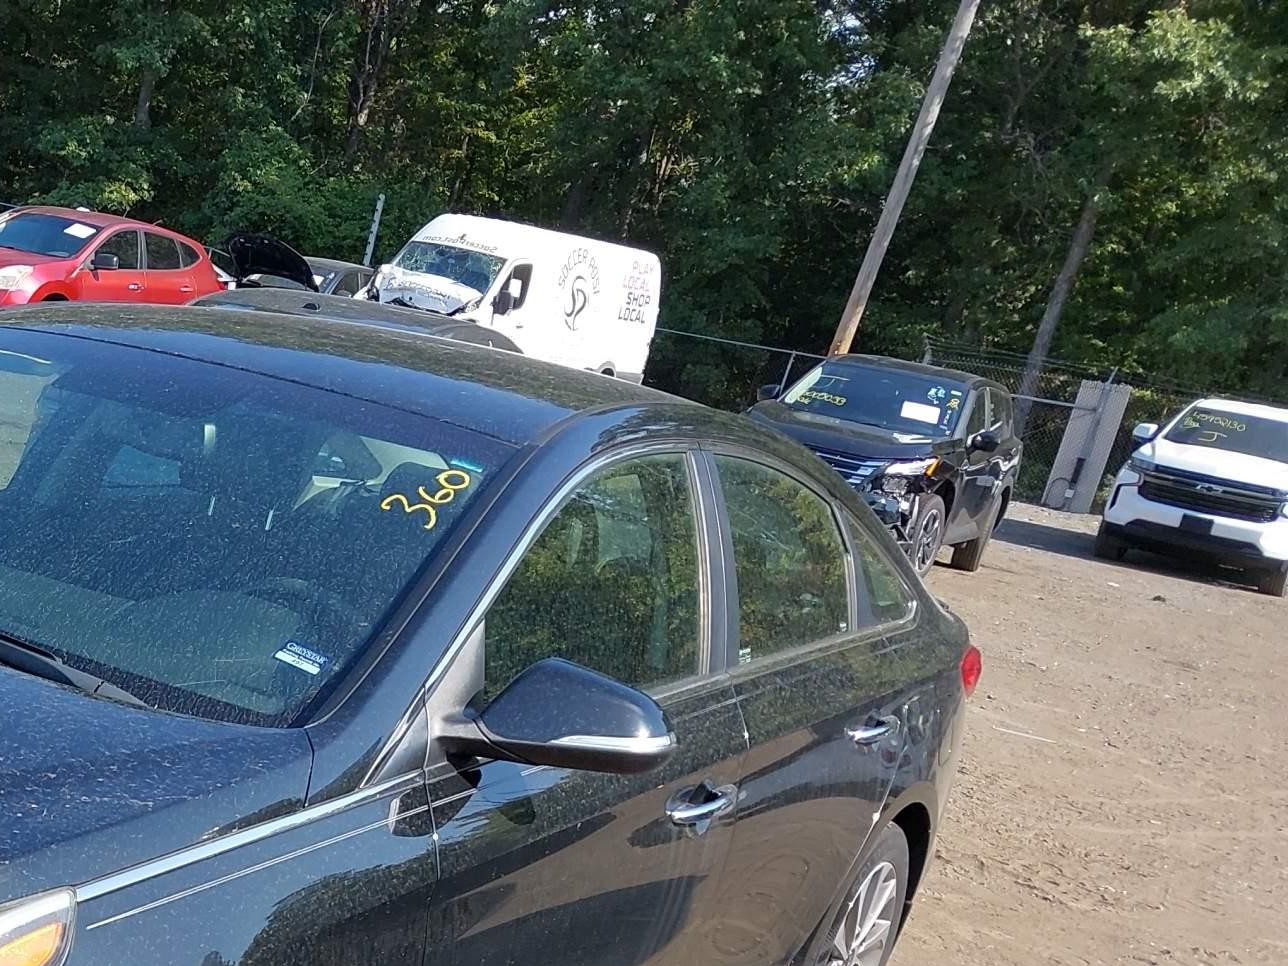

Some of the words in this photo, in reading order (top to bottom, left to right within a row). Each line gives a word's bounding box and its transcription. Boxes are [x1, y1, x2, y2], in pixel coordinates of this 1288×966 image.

[558, 247, 589, 289] SOCCER
[623, 274, 651, 292] LOCAL
[626, 291, 652, 308] SHOP
[617, 306, 646, 325] LOCAL
[380, 469, 472, 530] 360
[286, 642, 326, 664] GREYSTAR
